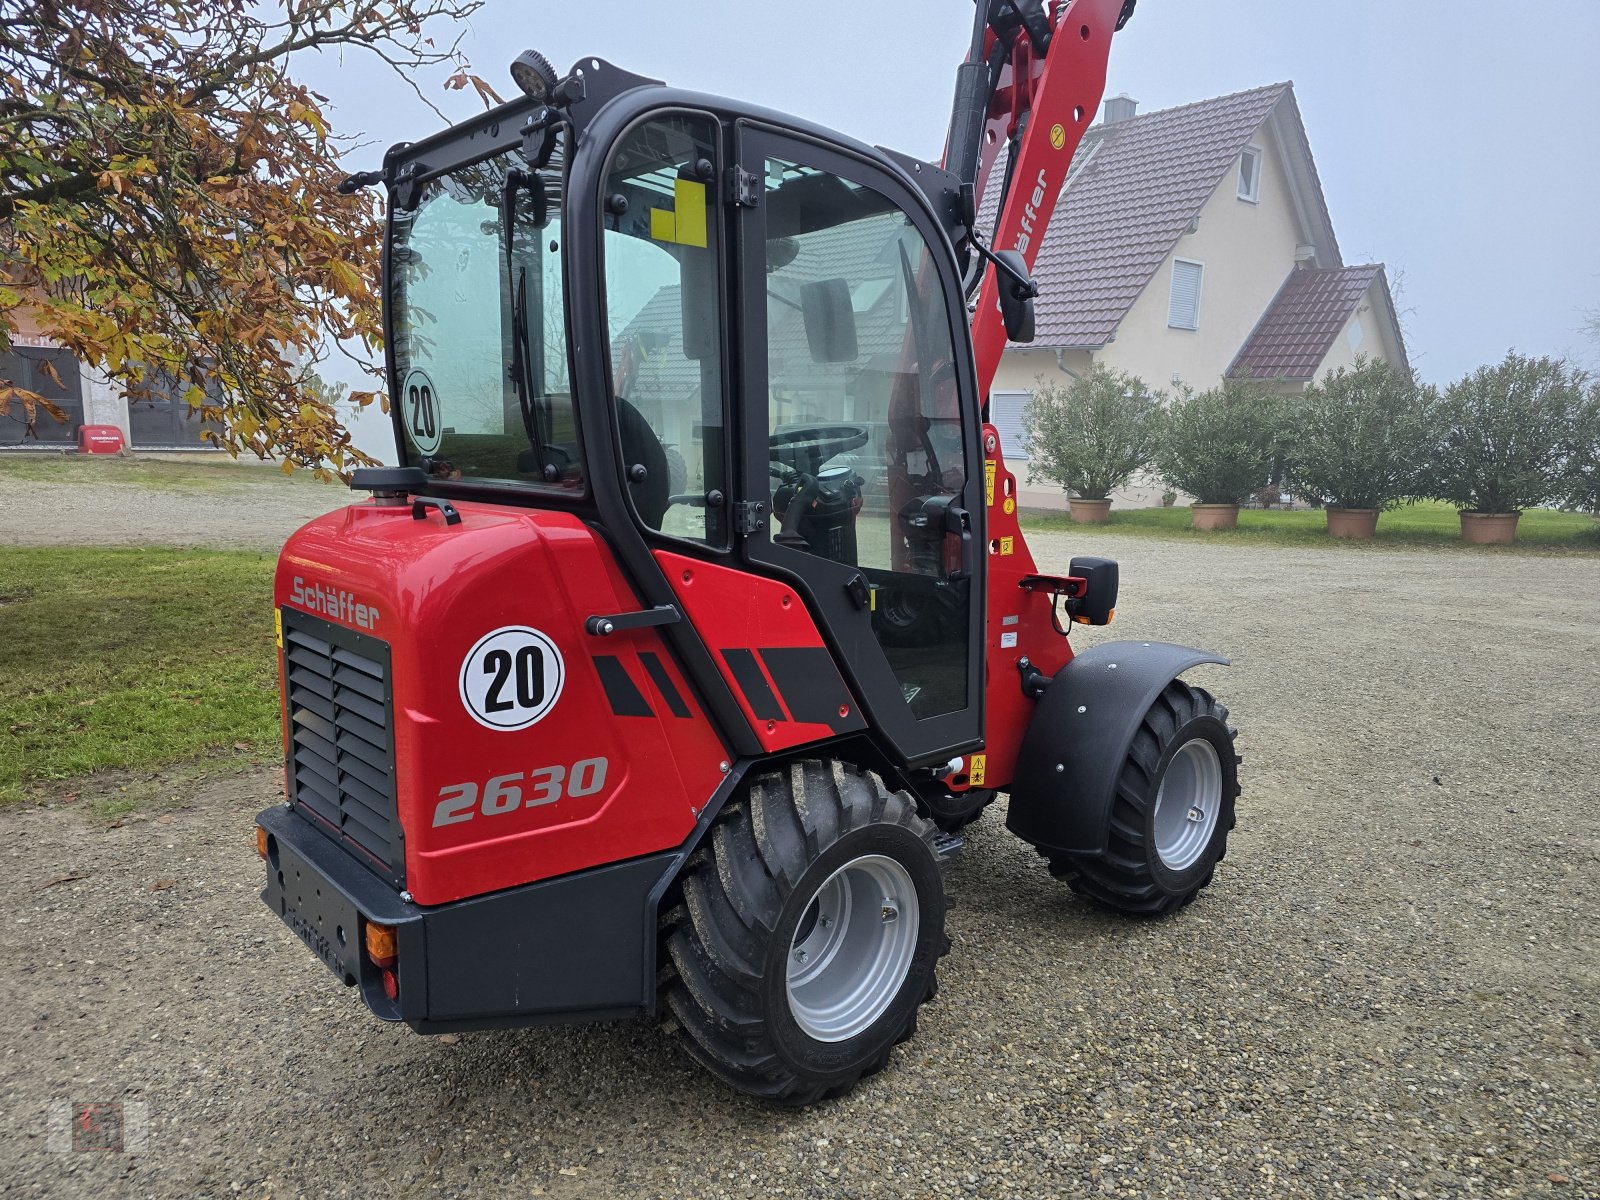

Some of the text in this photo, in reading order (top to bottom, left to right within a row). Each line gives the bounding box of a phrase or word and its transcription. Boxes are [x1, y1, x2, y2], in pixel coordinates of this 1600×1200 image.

[409, 384, 436, 438] 20
[289, 575, 380, 630] Schäffer
[483, 645, 545, 714] 20
[431, 756, 609, 829] 2630
